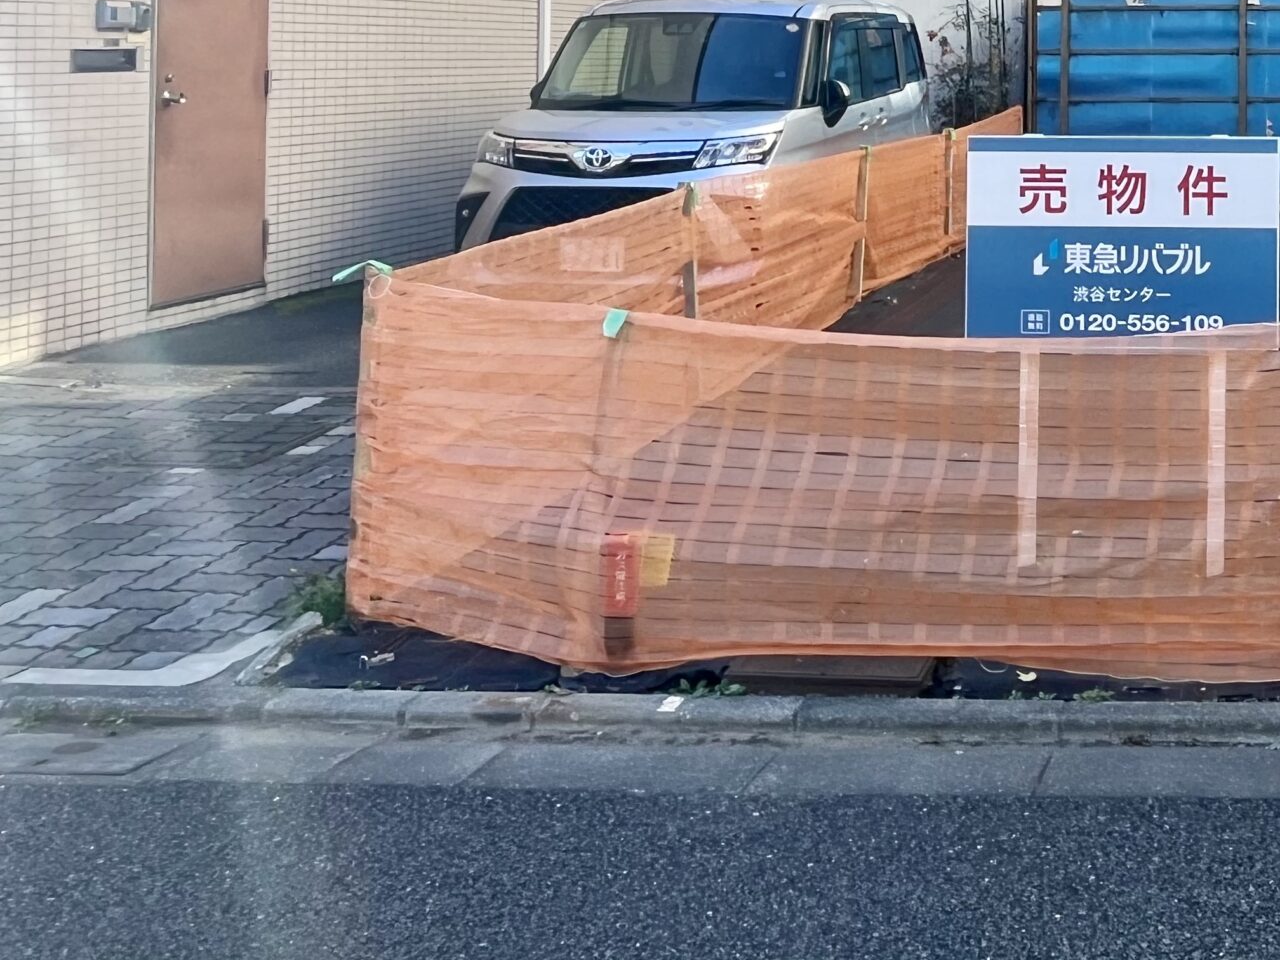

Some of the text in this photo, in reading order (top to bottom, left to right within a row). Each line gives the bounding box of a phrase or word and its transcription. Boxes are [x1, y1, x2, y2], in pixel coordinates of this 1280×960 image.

[1018, 163, 1228, 216] 売物件
[1063, 242, 1212, 276] 東急リバブル
[1072, 285, 1172, 303] 渋谷センター
[1059, 313, 1224, 332] 0120-556-109
